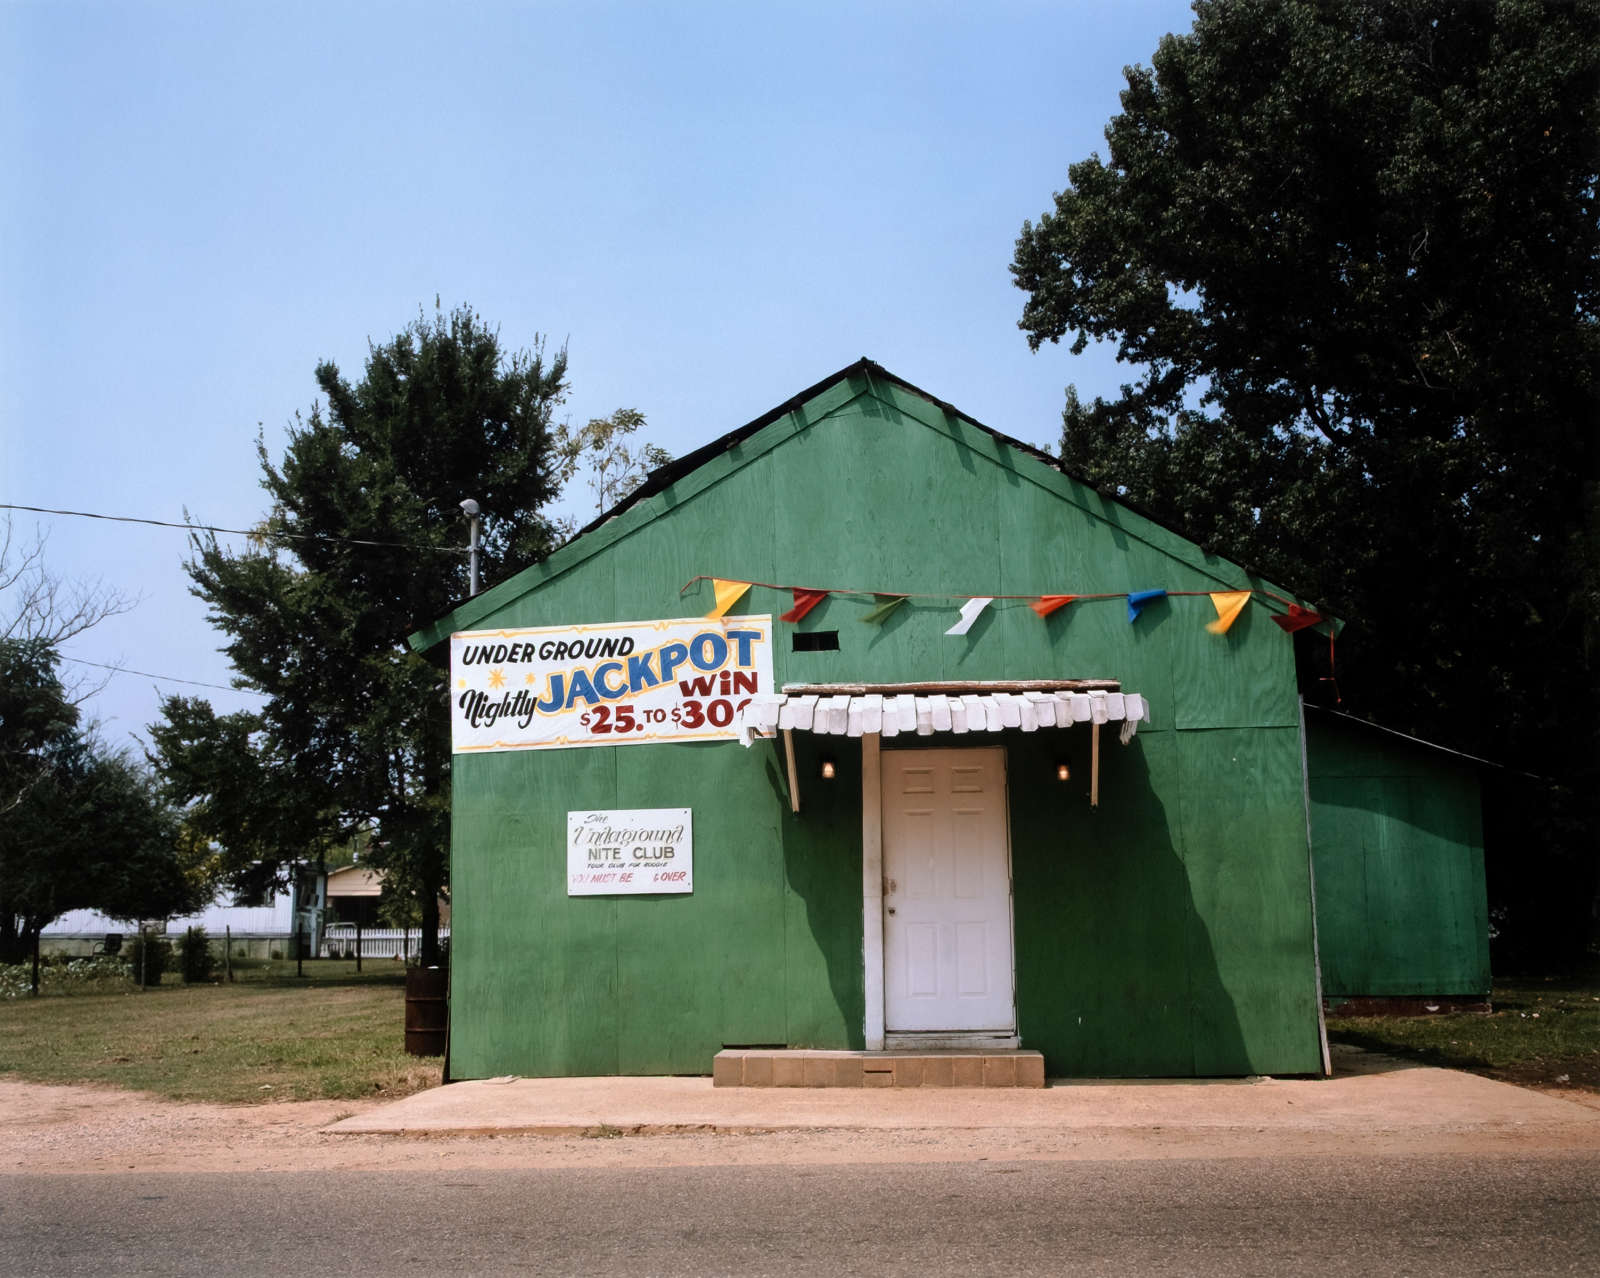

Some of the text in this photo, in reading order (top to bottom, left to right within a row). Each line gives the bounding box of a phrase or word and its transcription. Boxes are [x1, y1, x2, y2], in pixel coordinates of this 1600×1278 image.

[458, 630, 762, 729] Nightly JACKPOT
[580, 698, 752, 734] $25. TO $30
[588, 846, 675, 860] NITE CLUB
[619, 872, 633, 883] BE
[660, 871, 687, 882] OVER
